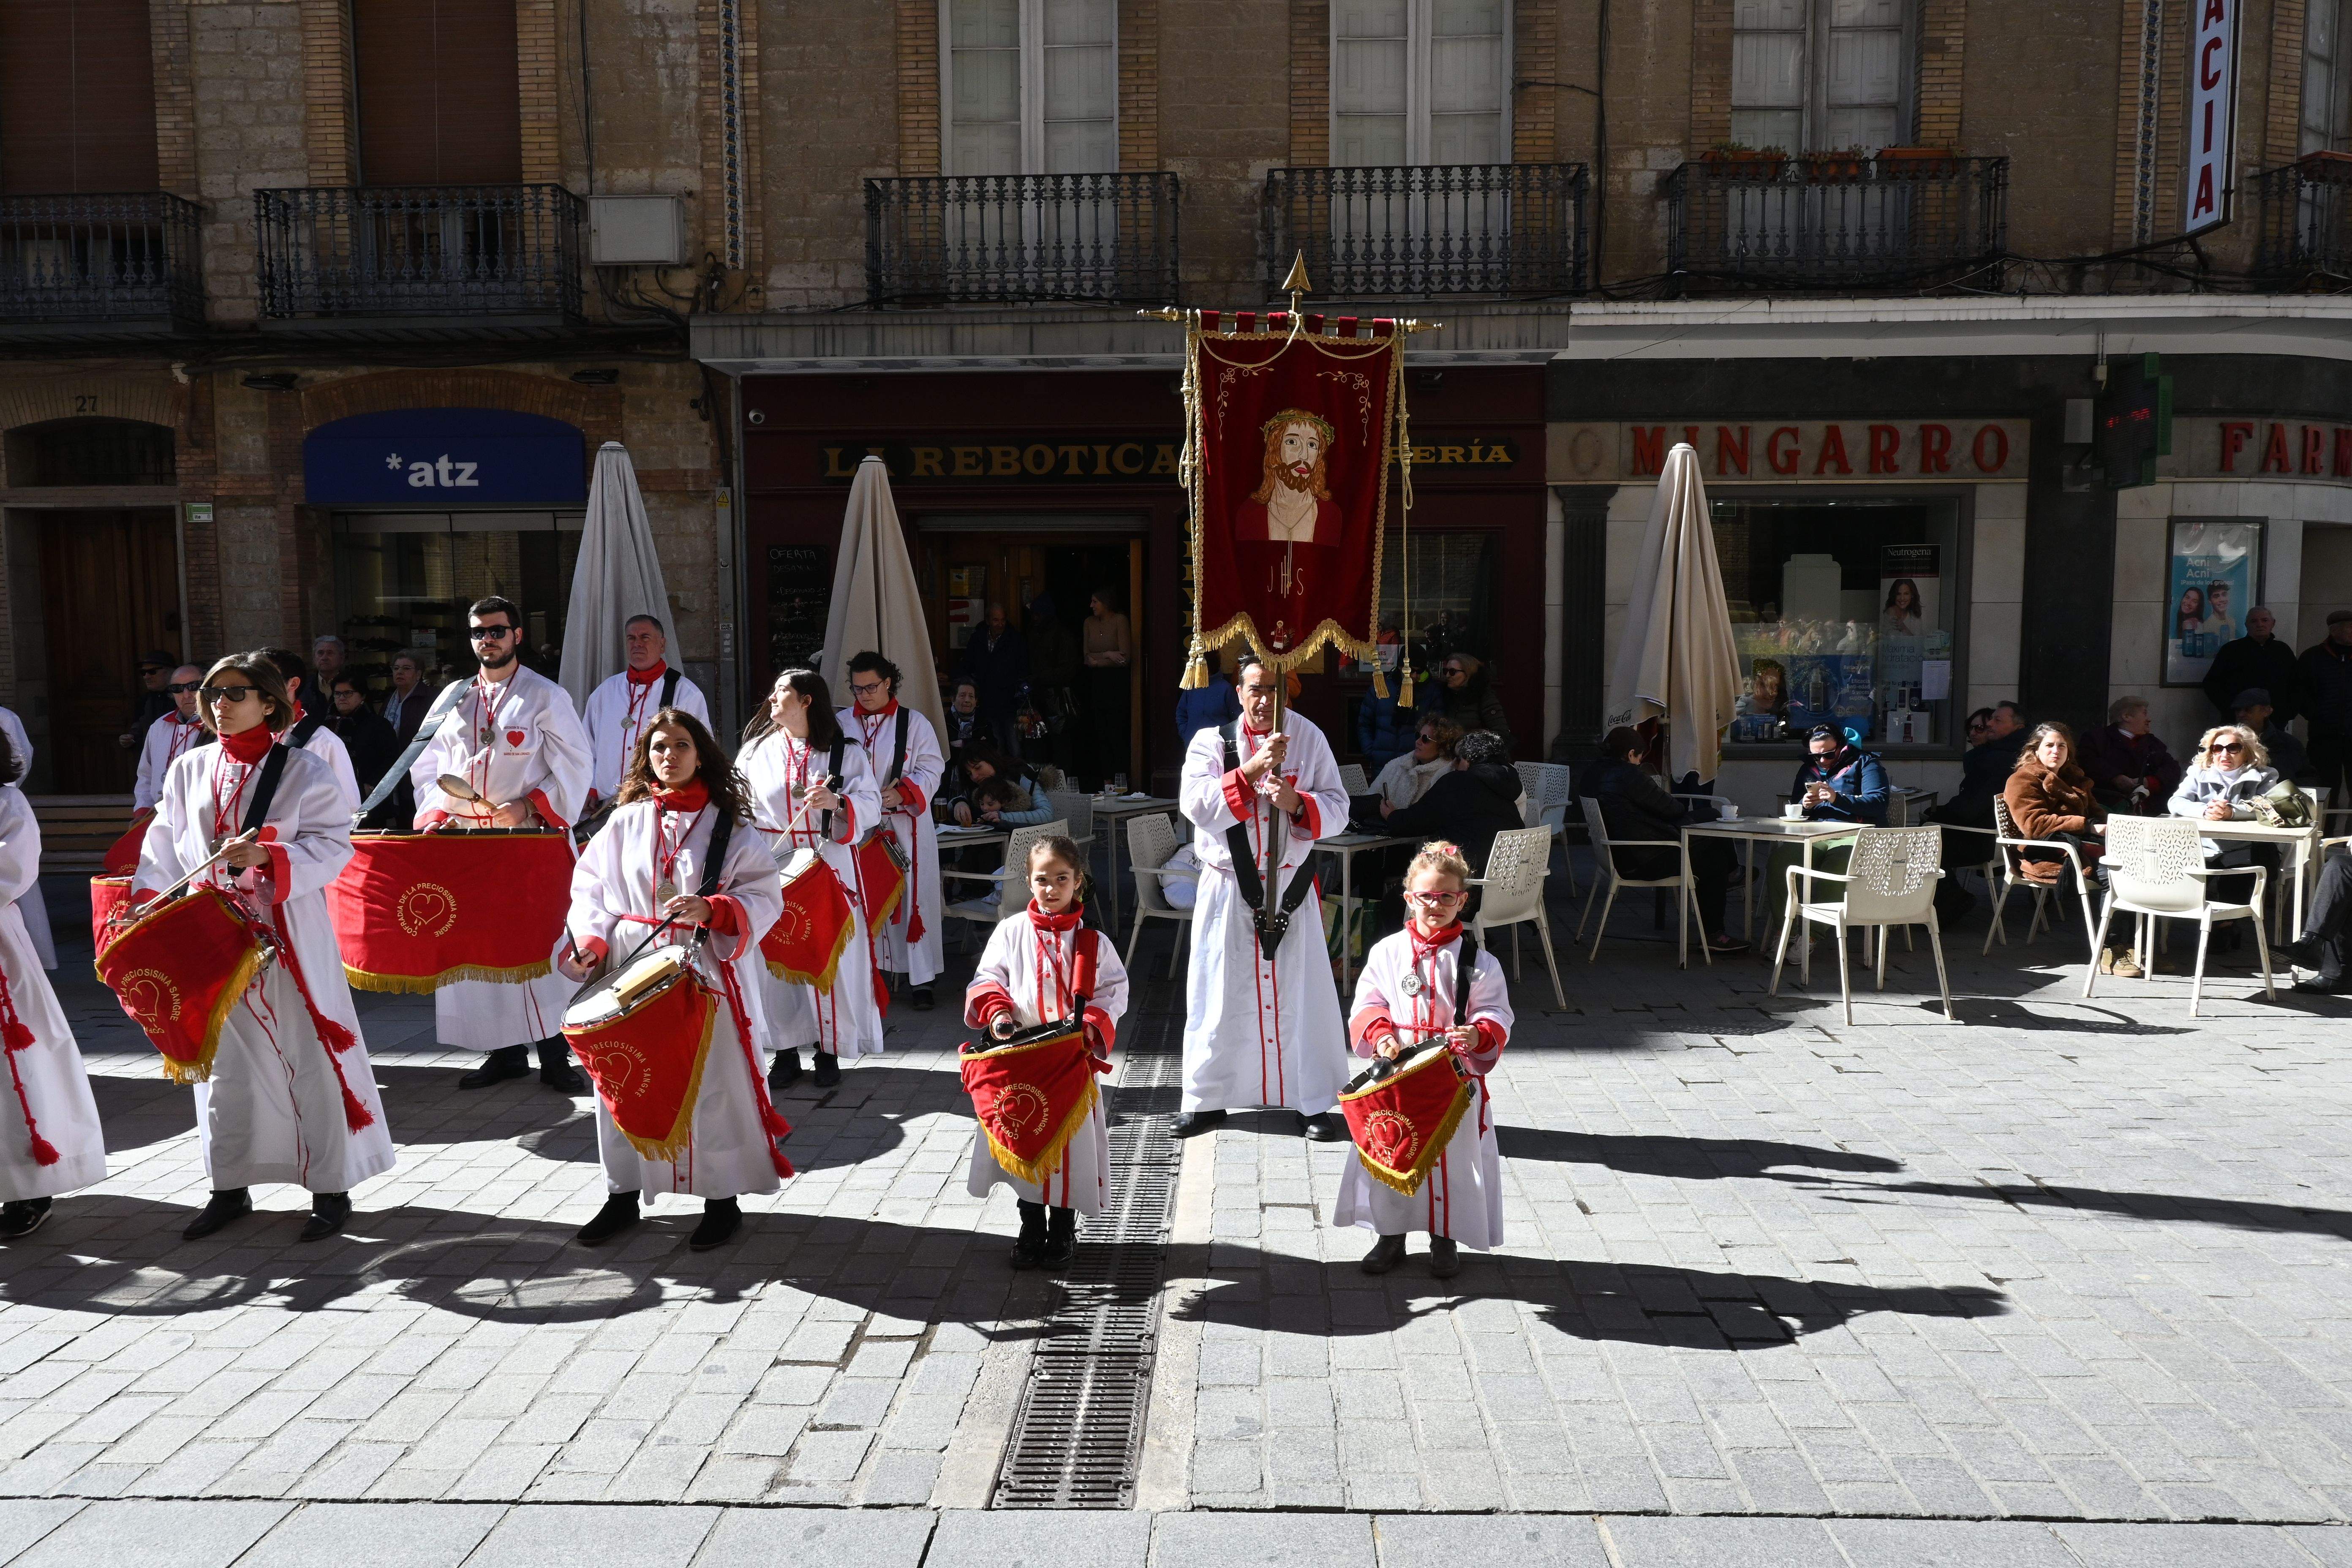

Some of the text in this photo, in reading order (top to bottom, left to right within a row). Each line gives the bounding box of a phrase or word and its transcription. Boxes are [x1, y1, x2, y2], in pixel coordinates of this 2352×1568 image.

[75, 396, 97, 412] 27
[909, 444, 1178, 476] REBOTICA
[770, 549, 816, 561] OFERTA
[1888, 547, 1932, 558] Neutrogena
[397, 883, 457, 937] COFRADIA DE LA PRECIOSISIMA SANGRE
[801, 918, 811, 941] SANGRE
[121, 969, 172, 987] PRECIOSISIMA
[120, 987, 128, 998] LA
[169, 986, 182, 1022] SANGRE
[590, 1041, 647, 1064] PRECIOSISIMA
[634, 1068, 651, 1097] SANGRE
[993, 1083, 1049, 1140] COFRADIA DE LA PRECIOSISIMA SANGRE
[1365, 1126, 1371, 1136] DE
[1369, 1109, 1415, 1131] PRECIOSISIMA
[1405, 1132, 1419, 1160] SANGRE
